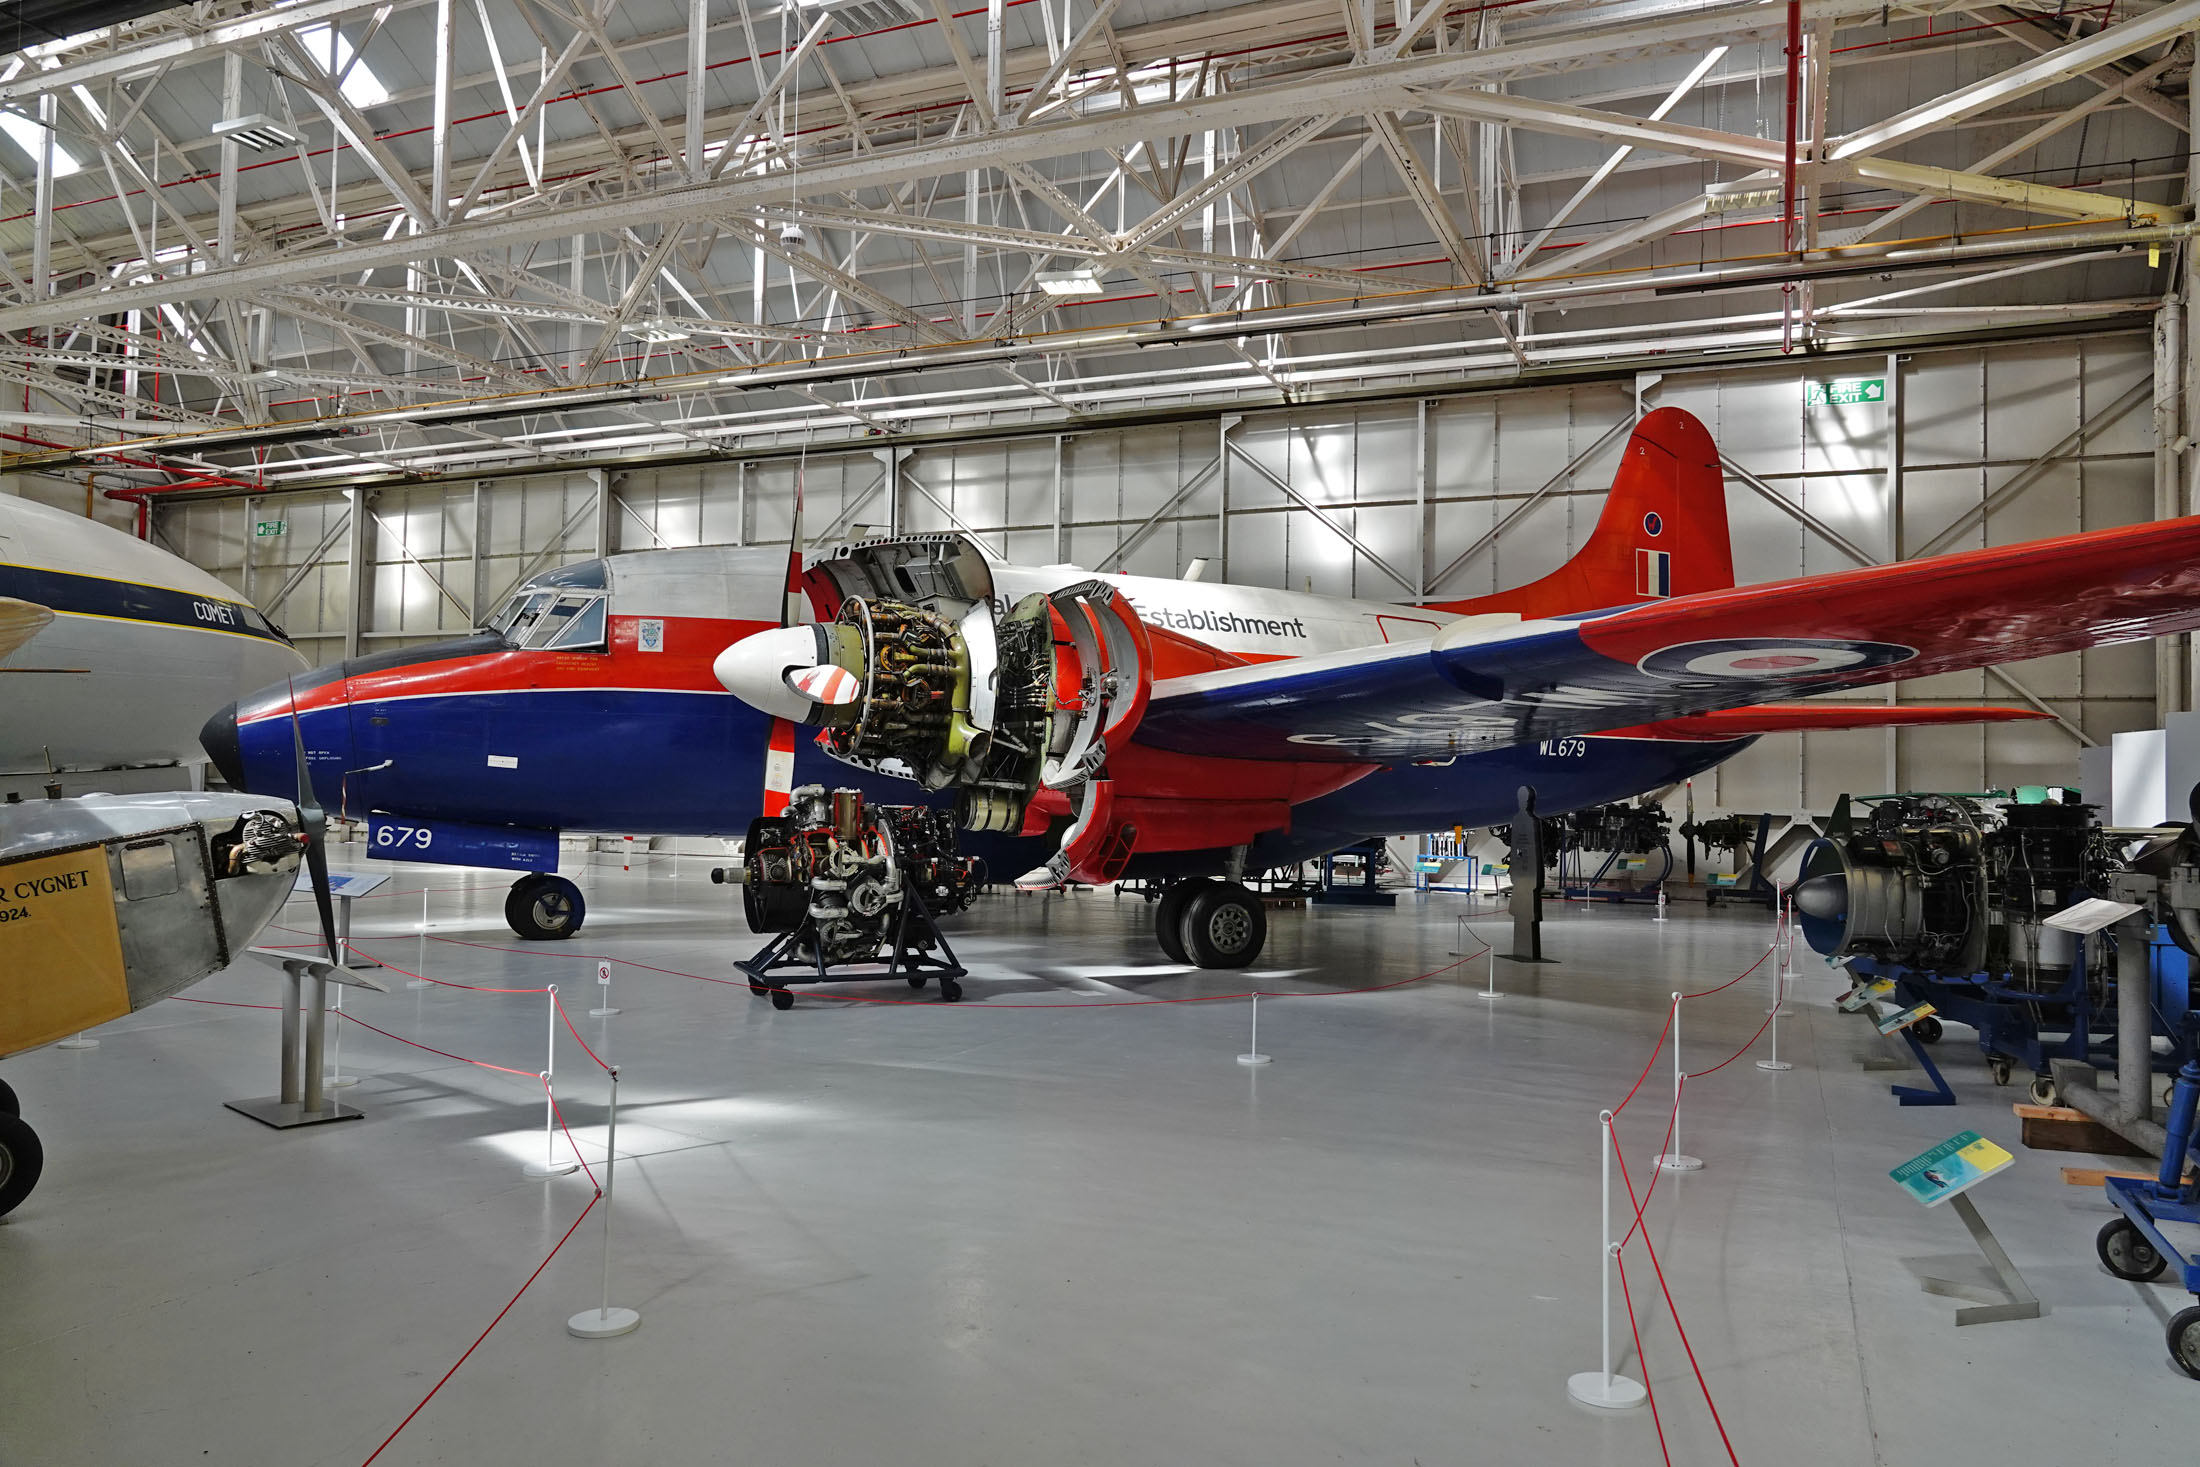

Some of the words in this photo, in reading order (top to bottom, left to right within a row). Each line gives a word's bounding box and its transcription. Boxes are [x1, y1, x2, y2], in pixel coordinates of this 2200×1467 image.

[1830, 383, 1862, 394] FIRE
[1830, 393, 1862, 403] EXIT
[1679, 421, 1685, 430] 2
[1639, 446, 1646, 455] 2
[193, 601, 236, 626] COMET
[1133, 604, 1307, 638] Establishment
[1539, 739, 1586, 757] WL679
[376, 825, 433, 849] 679
[14, 870, 89, 899] CYGNET
